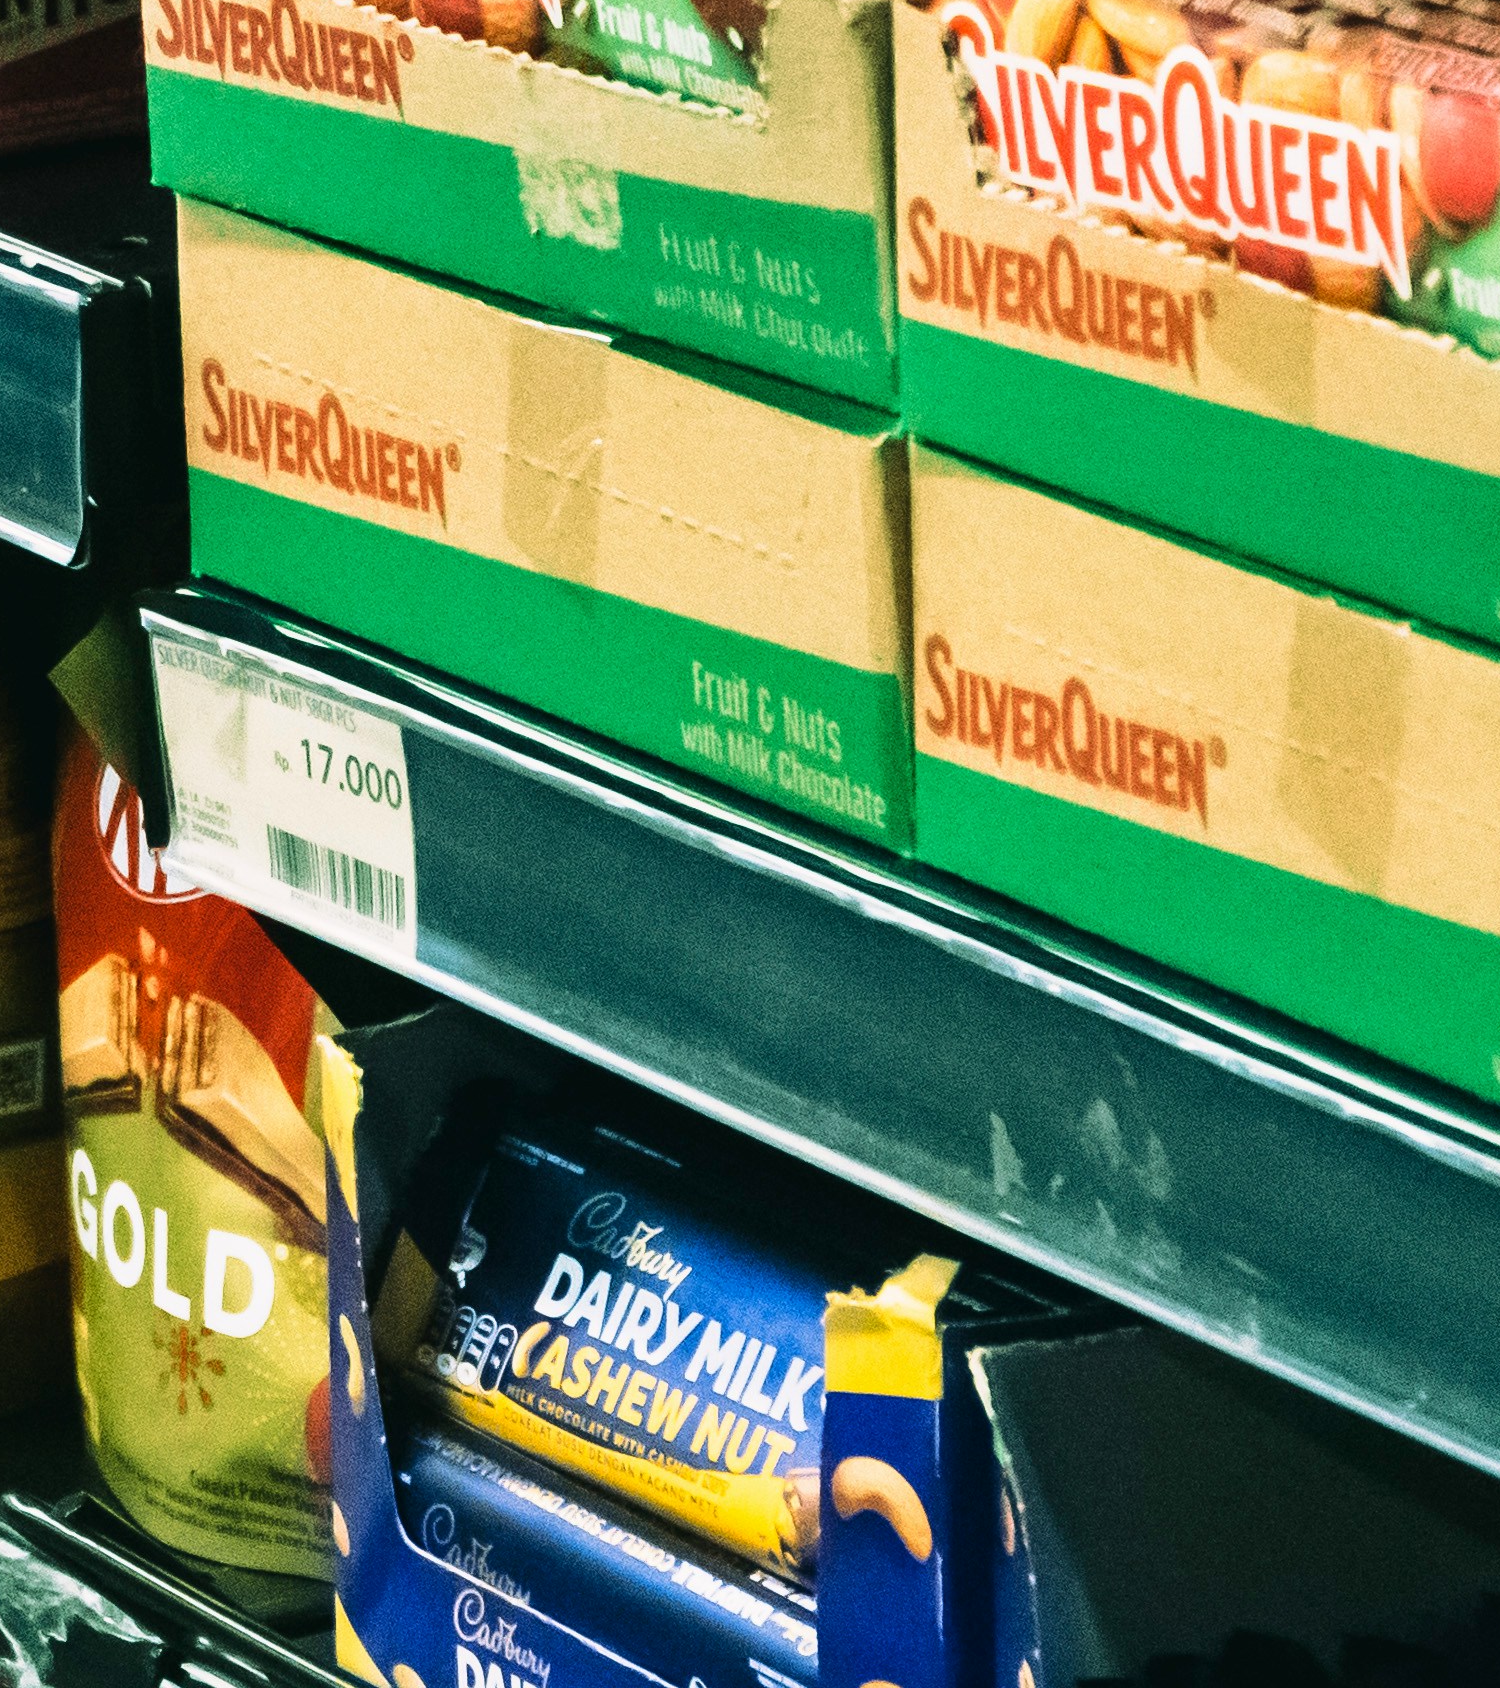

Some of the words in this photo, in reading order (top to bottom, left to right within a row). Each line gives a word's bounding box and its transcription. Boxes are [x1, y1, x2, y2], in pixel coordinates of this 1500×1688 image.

[662, 17, 713, 68] Nuts
[947, 14, 1408, 292] SILVERQUEEN
[657, 221, 721, 277] Fruit
[754, 246, 821, 306] Nuts
[700, 287, 748, 330] Milk
[907, 196, 1199, 380] SILVERQUEEN
[201, 358, 448, 531] SILVERQUEEN
[692, 661, 749, 723] Fruit
[782, 693, 843, 764] Nuts
[924, 633, 1209, 830] SILVERQUEEN
[301, 738, 402, 811] 17.000
[680, 720, 724, 758] with
[726, 731, 772, 782] Milk
[776, 747, 887, 830] Chocolate
[69, 1147, 276, 1340] GOLD
[567, 1190, 693, 1305] Cadbury
[533, 1251, 703, 1368] DAIRY
[699, 1321, 825, 1434] MILK
[502, 1405, 552, 1439] COKELAT
[587, 1444, 636, 1480] DENGAN
[506, 1383, 534, 1406] MILK
[538, 1396, 610, 1443] CHOCOLATE
[612, 1429, 646, 1456] WITH
[511, 1320, 698, 1447] CASHEW
[690, 1397, 798, 1479] NUT
[453, 1587, 552, 1688] Cadbury
